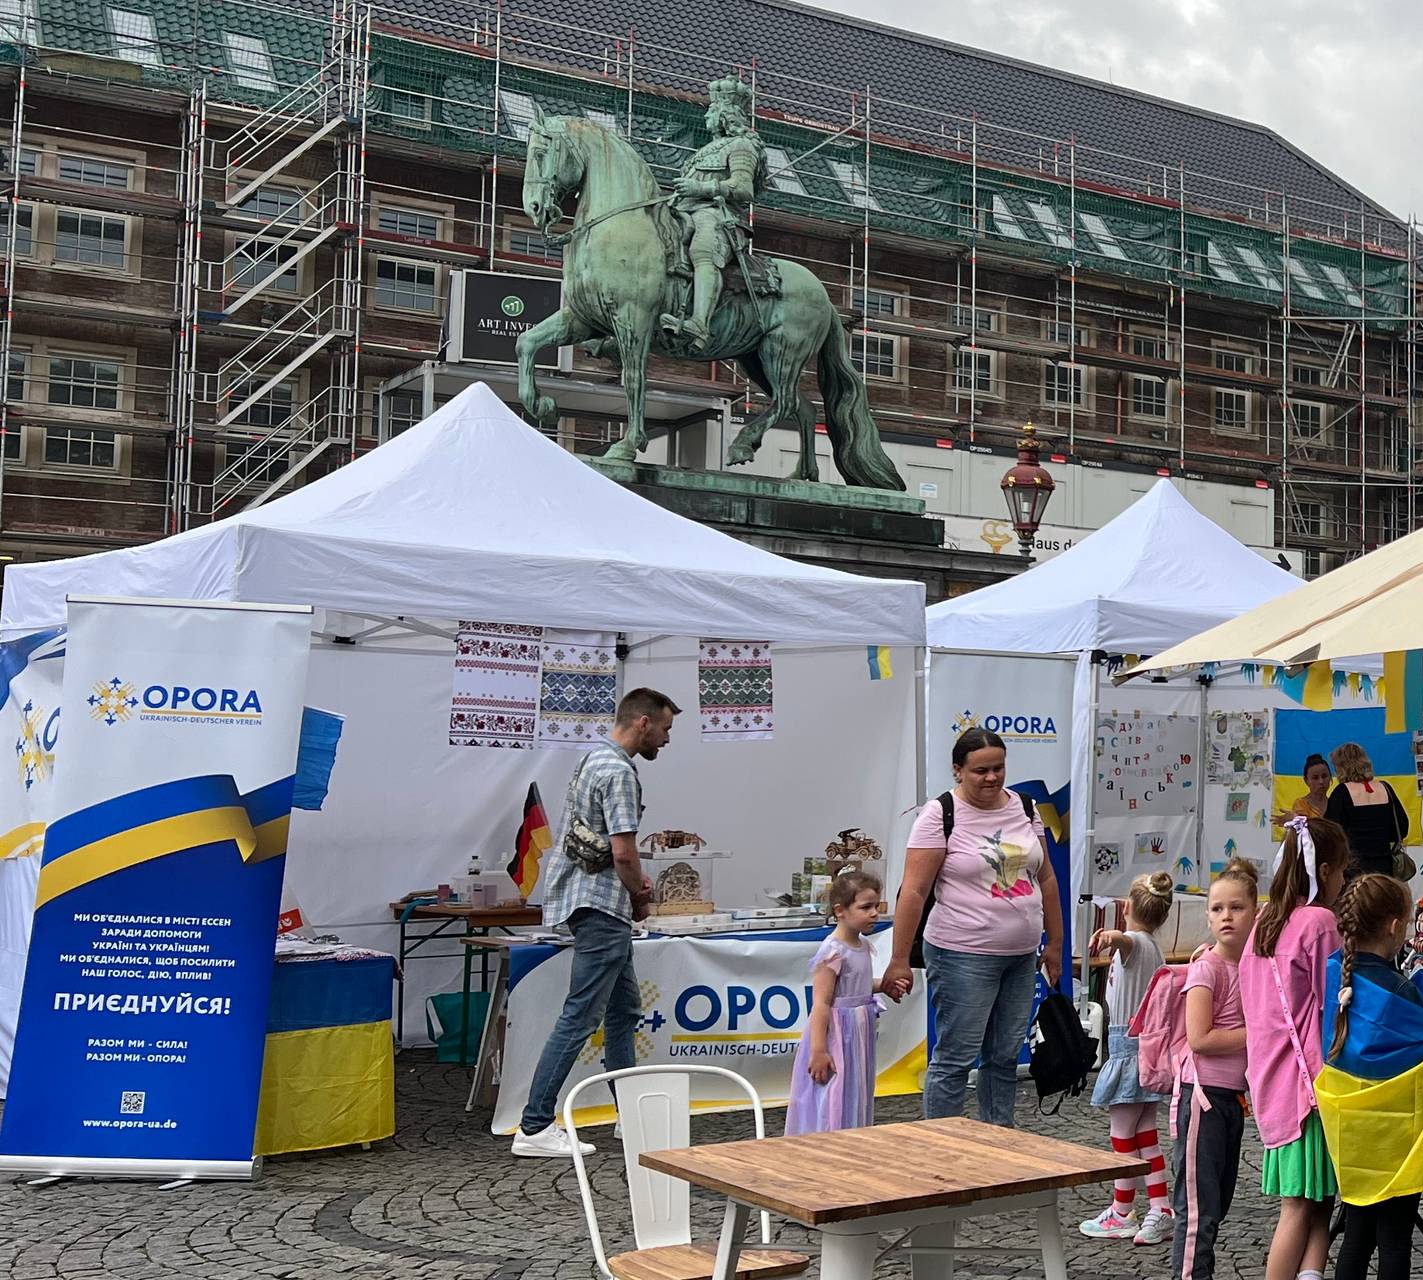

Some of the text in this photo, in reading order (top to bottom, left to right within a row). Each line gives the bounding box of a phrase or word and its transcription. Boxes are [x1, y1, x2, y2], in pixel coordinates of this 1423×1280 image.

[478, 318, 501, 329] ART
[143, 685, 262, 713] OPORA
[140, 714, 262, 726] UKRAINISCH-DEUTSCHER VEREIN
[984, 715, 1057, 734] OPORA
[73, 913, 91, 922] МИ
[92, 914, 163, 924] ОБ'ЄДНАЛИСЯ
[172, 917, 200, 926] МІСТІ
[201, 918, 231, 927] ЕССЕН
[101, 928, 202, 939] ЗАРАДИ ДОПОМОГИ
[92, 941, 210, 953] УКРАЇНІ ТА УКРАЇНЦЯМ!
[59, 954, 76, 963] МИ
[155, 958, 179, 966] ЩОБ
[180, 958, 235, 968] ПОСИЛИТИ
[81, 969, 211, 980] НАШ ГОЛОС, ДІЮ, ВПЛИВ!
[53, 992, 232, 1015] ПРИЄДНУЙСЯ!
[674, 985, 814, 1032] OPO
[88, 1039, 124, 1047] РАЗОМ
[128, 1040, 145, 1048] МИ
[156, 1040, 188, 1049] СИЛА!
[669, 1042, 800, 1057] UKRAINISCH-DEUT
[86, 1053, 122, 1061] РАЗОМ
[124, 1054, 140, 1062] МИ
[147, 1054, 186, 1063] ОПОРА!
[83, 1119, 177, 1129] www.opora-ua.de
